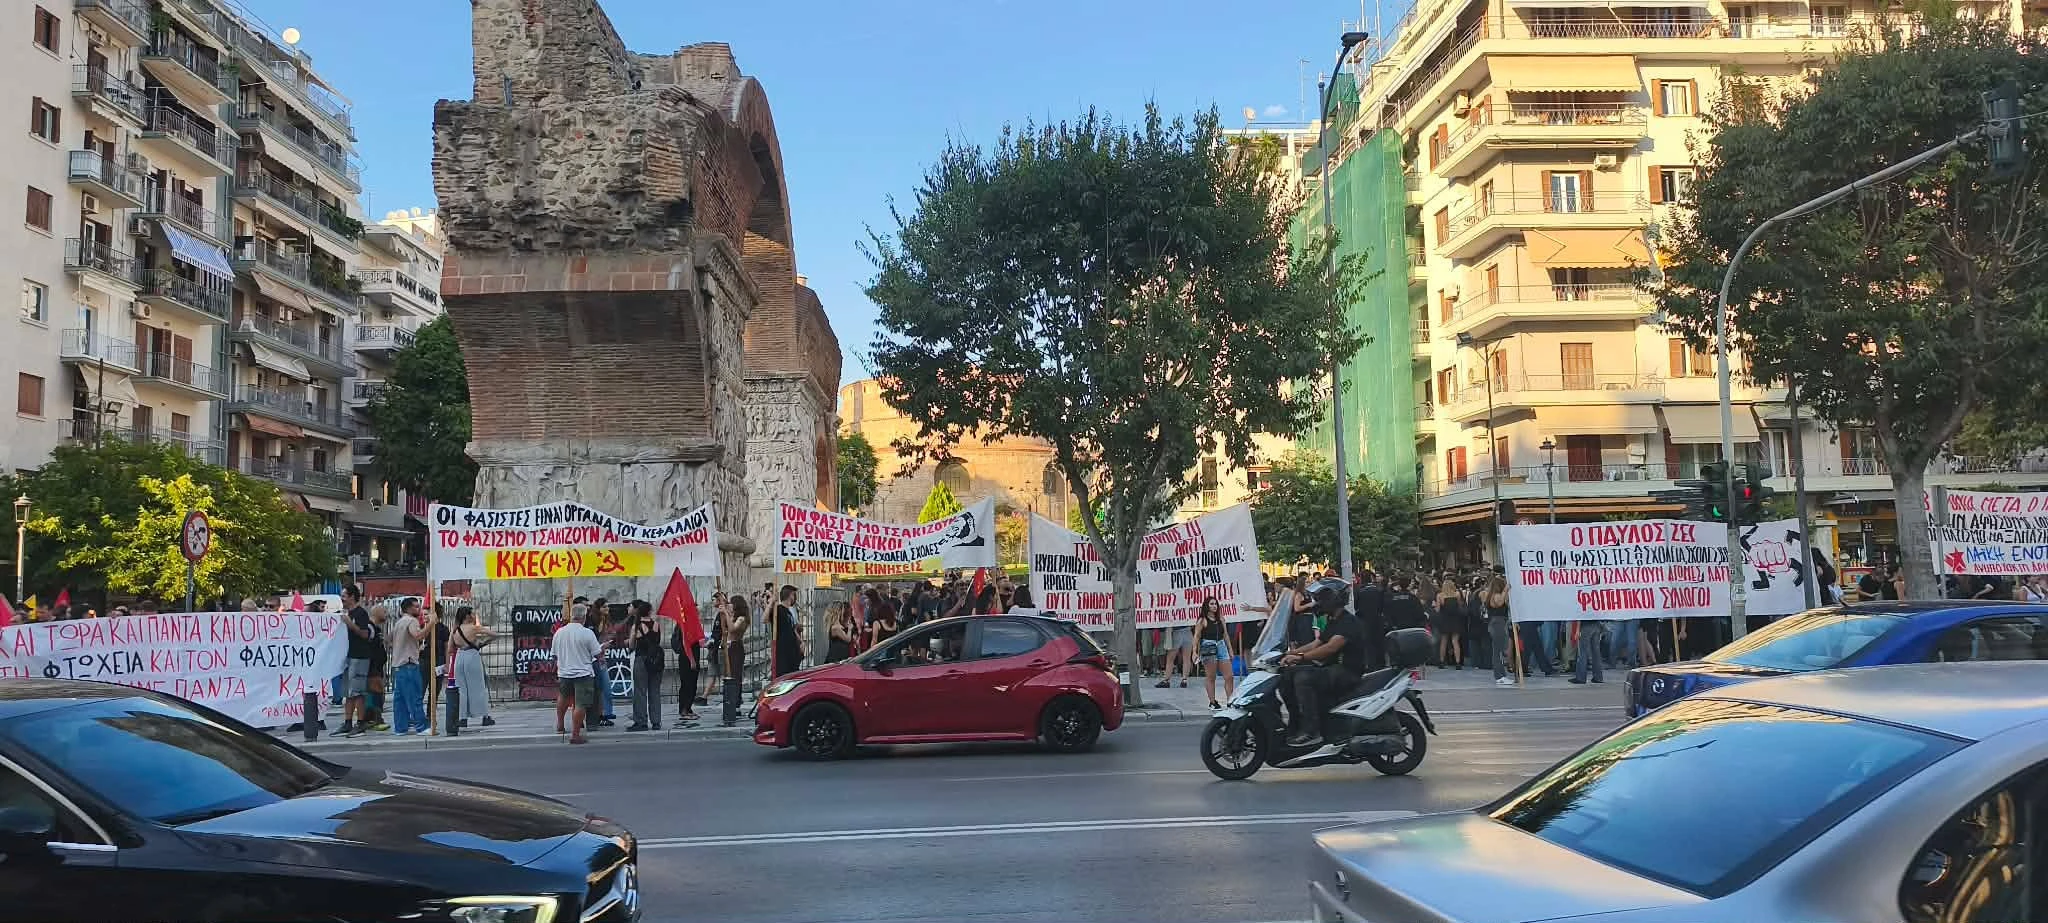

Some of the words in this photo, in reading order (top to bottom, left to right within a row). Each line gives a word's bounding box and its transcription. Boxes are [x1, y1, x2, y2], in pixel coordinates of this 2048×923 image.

[437, 507, 456, 525] ΟΙ
[464, 511, 531, 528] ΦΑΣΙΣΤΕΣ
[617, 521, 637, 538] ΤΟΥ
[780, 503, 807, 521] ΤΟΝ
[810, 511, 880, 534] ΦΑΣΙΣΜΟ
[438, 529, 459, 548] ΤΟ
[463, 529, 527, 548] ΦΑΣΙΣΜΟ
[530, 526, 600, 546] ΤΣΑΚΙΖΟΥΝ
[781, 521, 845, 544] ΑΓΩΝΕΣ
[1571, 526, 1584, 547] Ο
[1589, 523, 1665, 546] ΠΑΥΛΟΣ
[808, 540, 818, 557] ΟΙ
[784, 559, 858, 574] ΑΓΩΝΙΣΤΙΚΕΣ
[865, 560, 923, 575] ΚΙΝΗΣΕΙΣ
[1520, 568, 1544, 586] ΤΟΝ
[1549, 567, 1600, 586] ΦΑΣΙΣΜΟ
[526, 609, 562, 623] ΠΑΥΛΟ
[43, 621, 105, 651] ΤΩΡΑ
[109, 617, 144, 646] ΚΑΙ
[148, 615, 202, 644] ΠΑΝΤΑ
[211, 615, 236, 644] ΚΑΙ
[240, 614, 290, 642] ΟΠΩΣ
[295, 614, 315, 639] ΤΟ
[43, 650, 144, 679] ΦΤΩΧΕΙΑ
[150, 649, 181, 673] ΚΑΙ
[185, 645, 228, 671] ΤΟΝ
[240, 645, 316, 668] ΦΑΣΙΣΜΟ
[175, 675, 246, 701] ΠΑΝΤΑ
